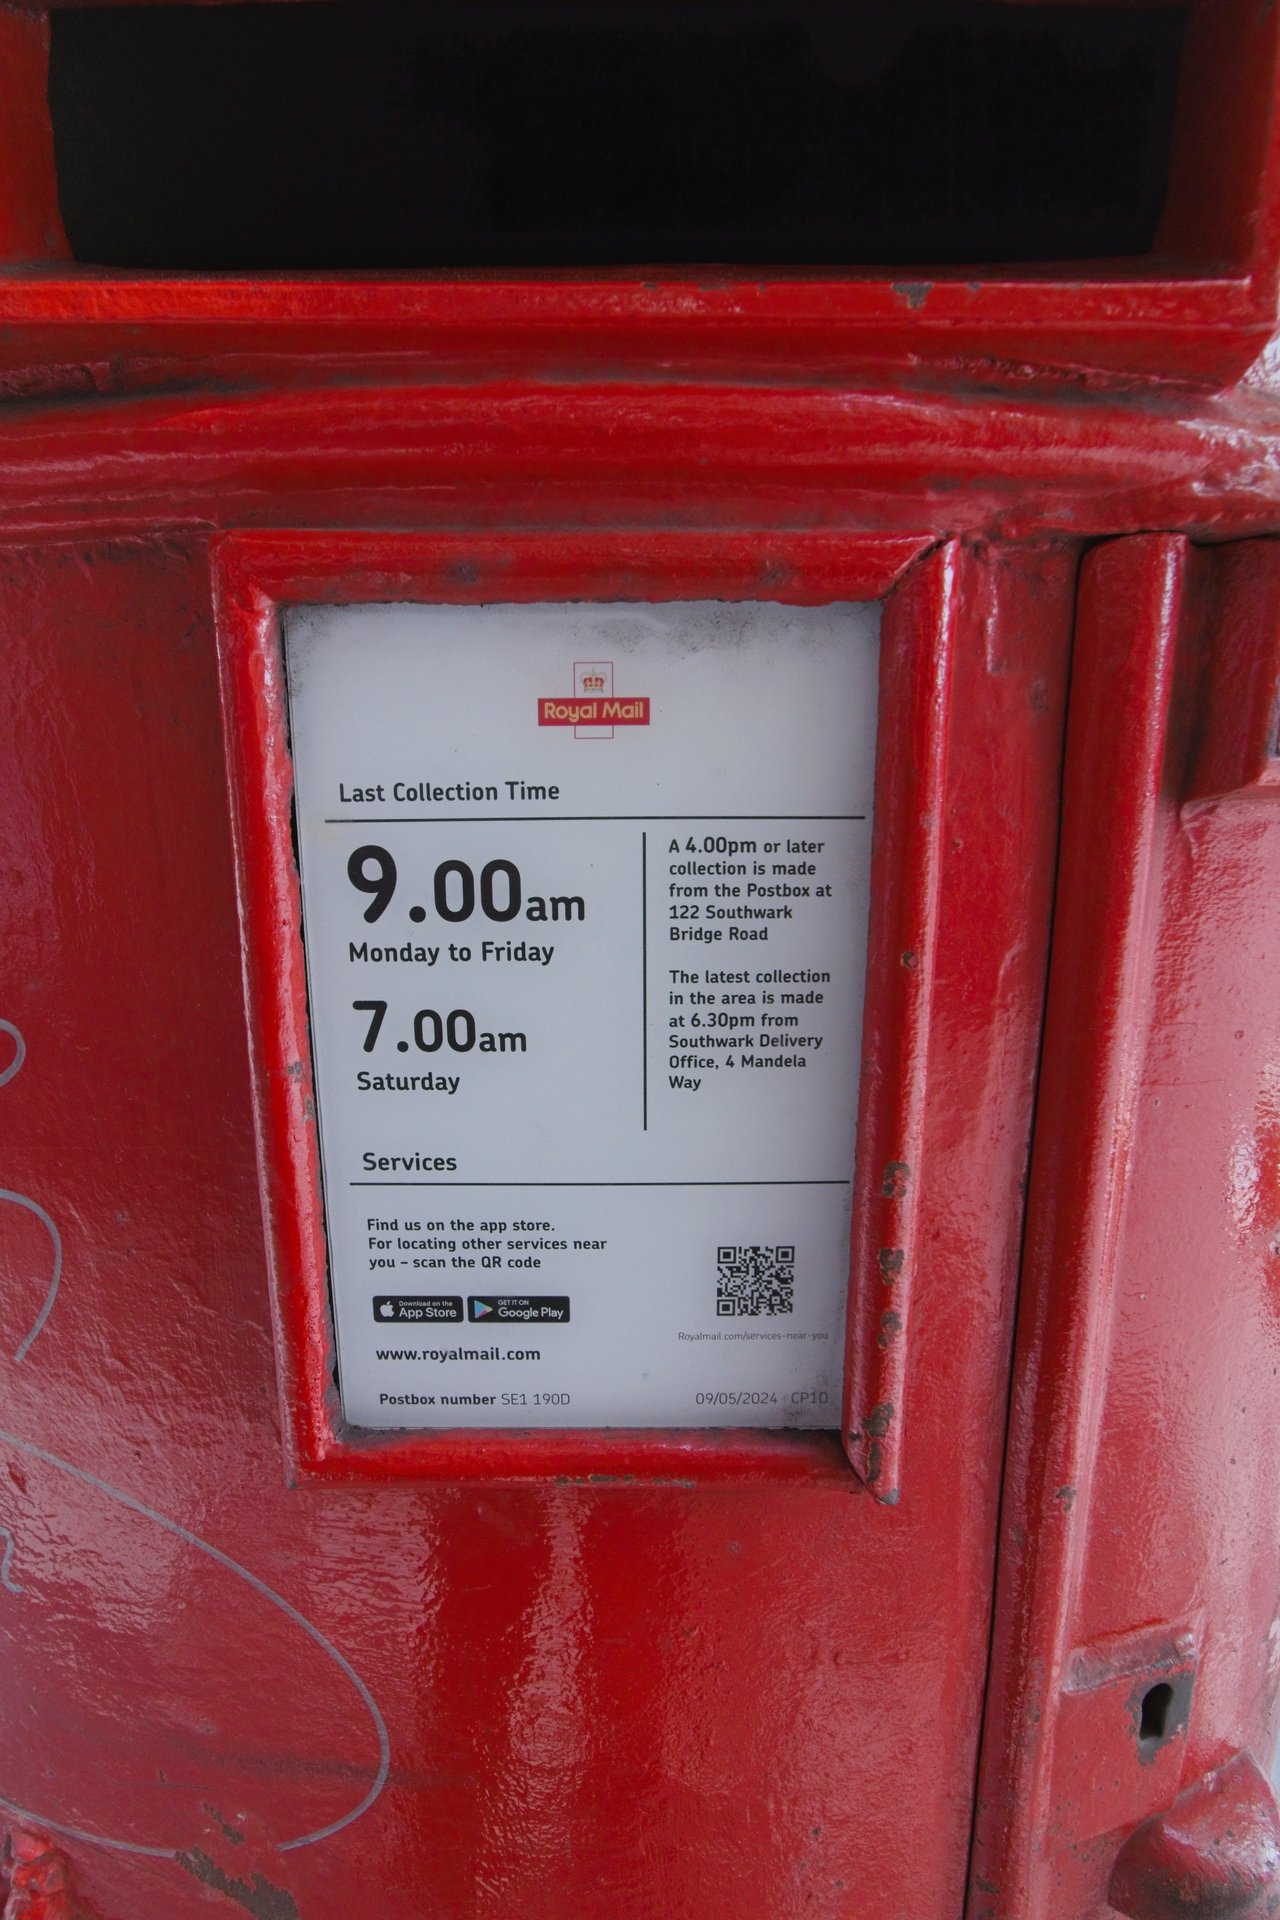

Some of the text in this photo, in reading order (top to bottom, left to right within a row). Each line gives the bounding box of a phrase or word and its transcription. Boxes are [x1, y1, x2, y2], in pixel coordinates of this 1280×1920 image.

[544, 701, 644, 723] Royal Mail
[340, 781, 559, 802] Last Collection Time
[669, 837, 824, 856] A 4.00pm or later
[670, 861, 816, 875] collection is made
[348, 845, 585, 923] 9.00am
[669, 883, 832, 897] from the Postbox at
[670, 905, 792, 919] 122 Southwark
[670, 927, 768, 943] Bridge Road
[349, 941, 554, 966] Monday to Friday
[669, 969, 830, 983] The latest collection
[670, 991, 823, 1004] in the area is made
[353, 1001, 526, 1052] 7.00am
[669, 1013, 798, 1030] at 6.30pm from
[669, 1034, 823, 1049] Southwark Delivery
[670, 1054, 806, 1069] Office, 4 Mandela
[357, 1072, 460, 1095] Saturday
[669, 1076, 701, 1091] Way
[363, 1152, 457, 1171] Services
[368, 1219, 554, 1233] Find us on the app store.
[369, 1237, 607, 1252] For locating other services near
[369, 1259, 395, 1270] you
[413, 1259, 445, 1268] scan
[451, 1256, 475, 1268] the
[482, 1256, 501, 1268] QR
[508, 1257, 541, 1268] code
[399, 1307, 457, 1320] App Store
[498, 1307, 564, 1320] Google Play
[678, 1331, 829, 1342] Royalmail.com/services-near-you
[376, 1347, 540, 1363] www.royalmail.com
[380, 1393, 570, 1405] Postbox number SE1 190D
[695, 1391, 829, 1406] 09/05/2024 CP1D
